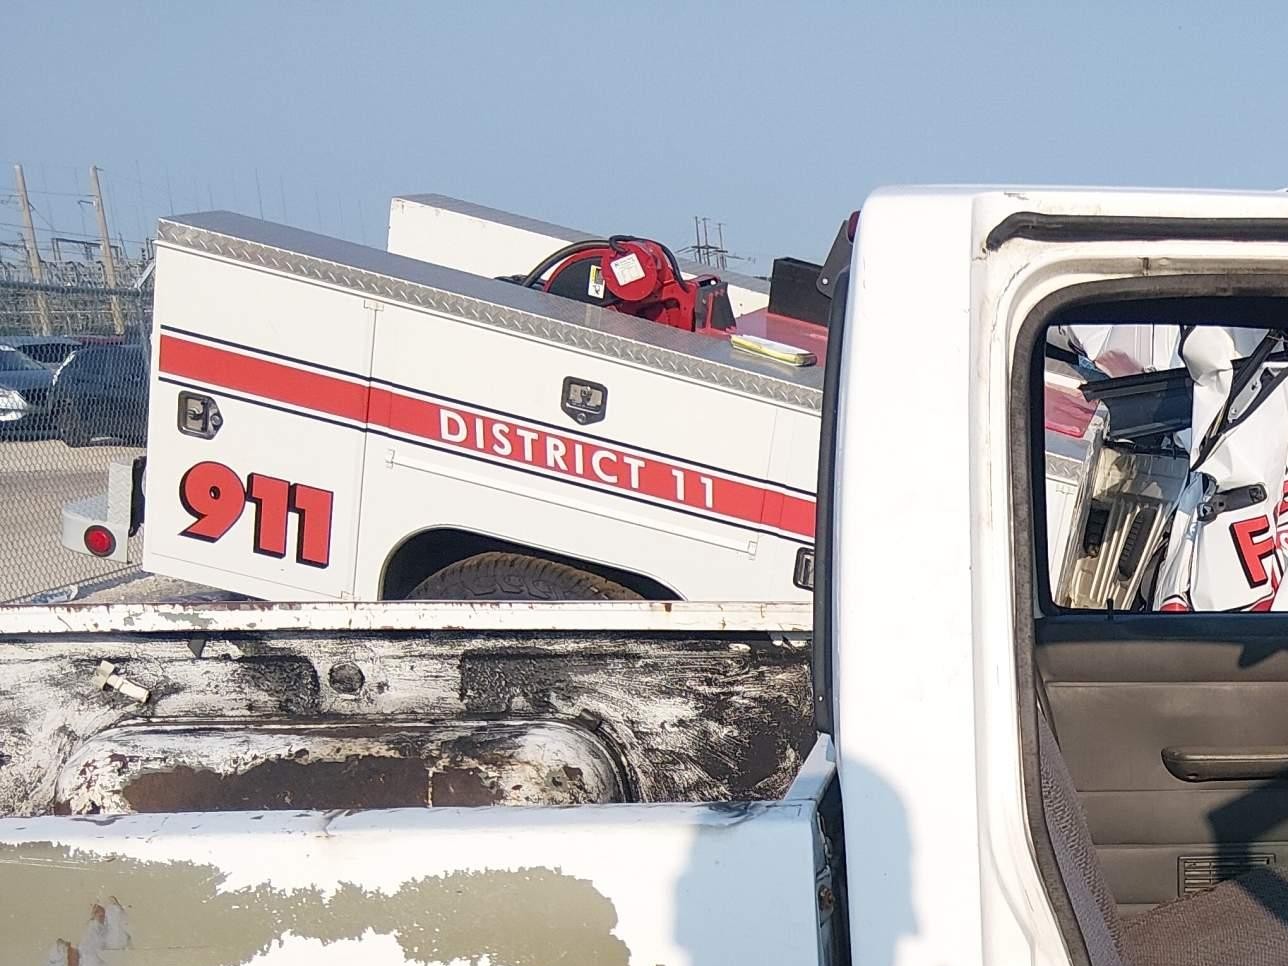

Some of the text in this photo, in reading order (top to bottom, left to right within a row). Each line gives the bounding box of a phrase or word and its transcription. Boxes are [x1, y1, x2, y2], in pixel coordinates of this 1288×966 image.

[439, 408, 713, 509] DISTRICT 11
[177, 461, 334, 569] 911
